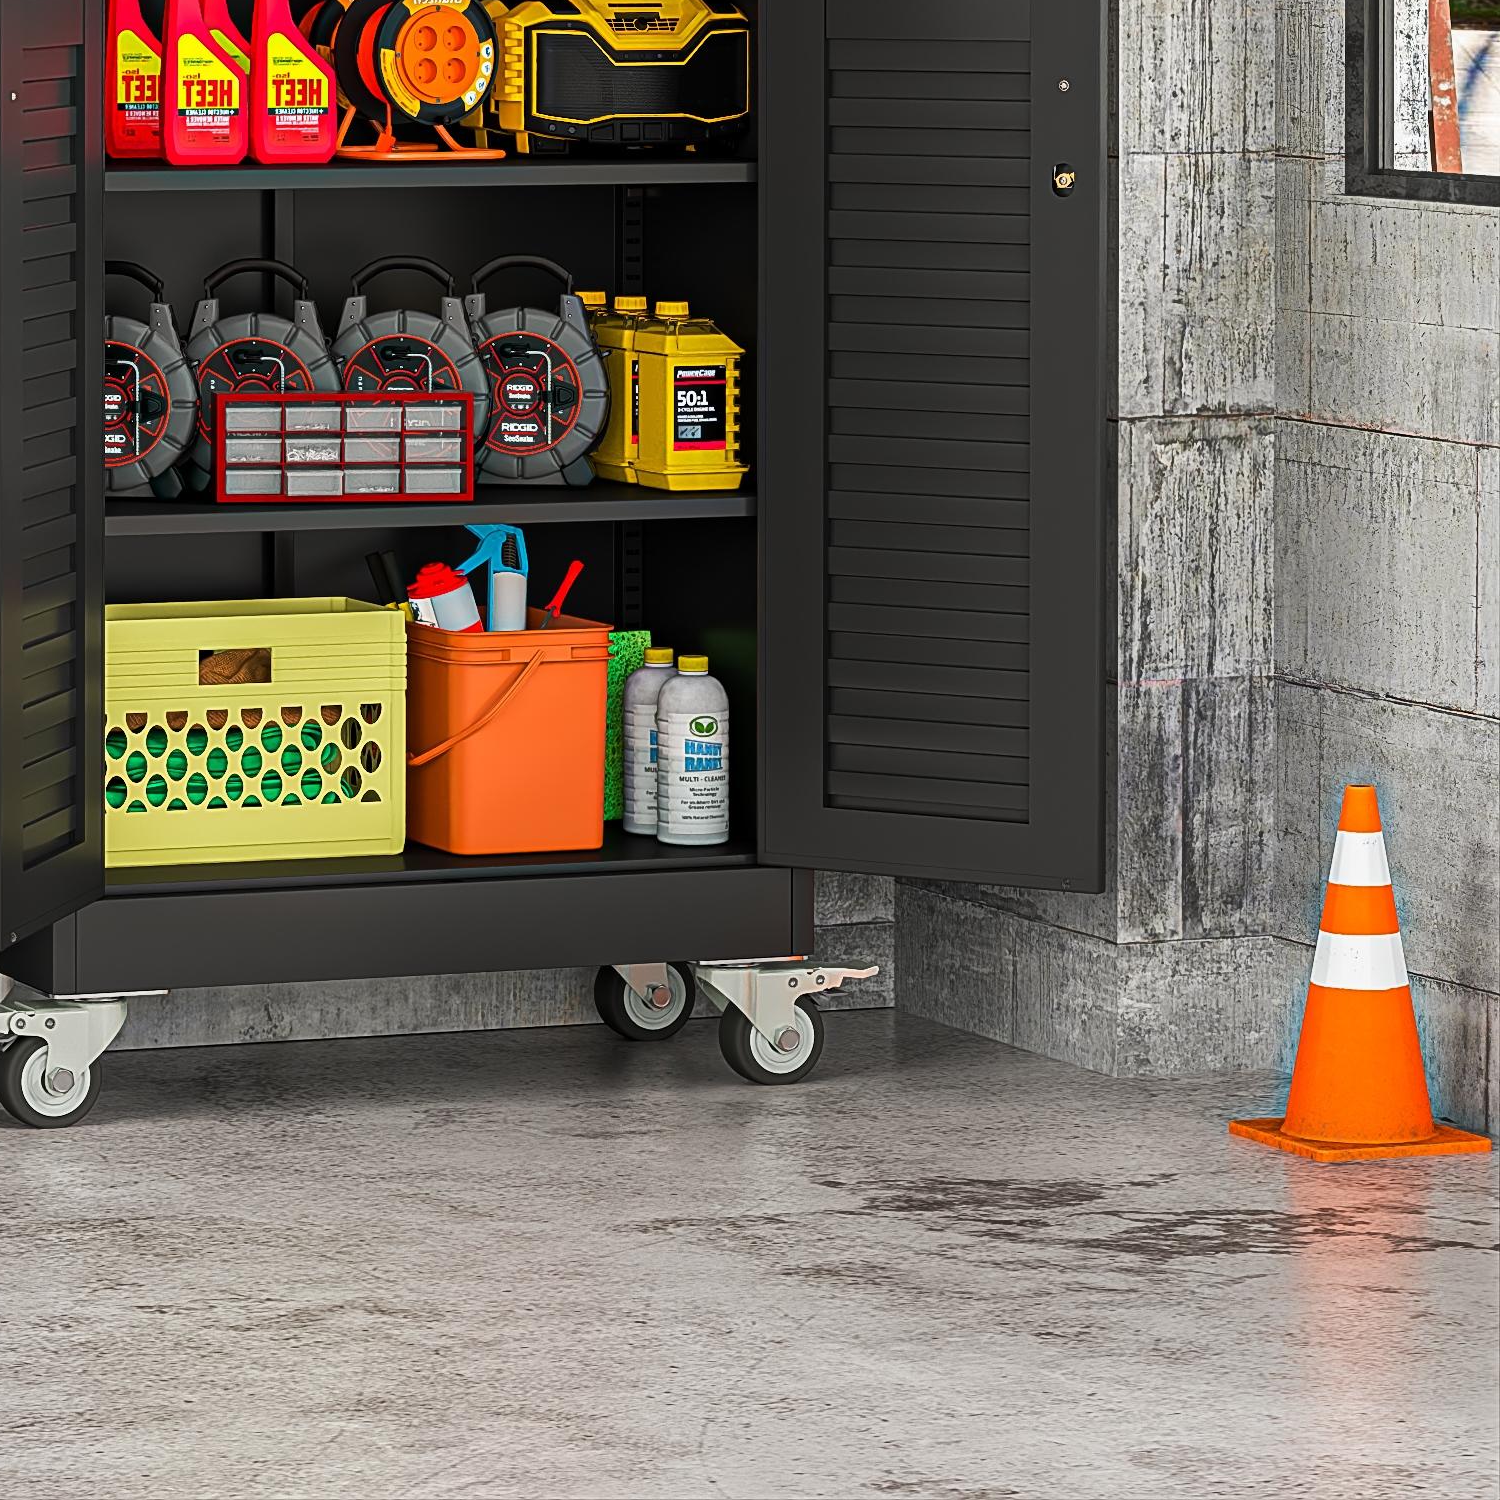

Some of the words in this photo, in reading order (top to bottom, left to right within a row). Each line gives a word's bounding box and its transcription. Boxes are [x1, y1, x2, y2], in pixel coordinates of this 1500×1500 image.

[677, 390, 709, 407] 50:1
[501, 422, 539, 432] RIDGID
[503, 434, 534, 443] SeeSnake
[679, 775, 699, 783] MULTI
